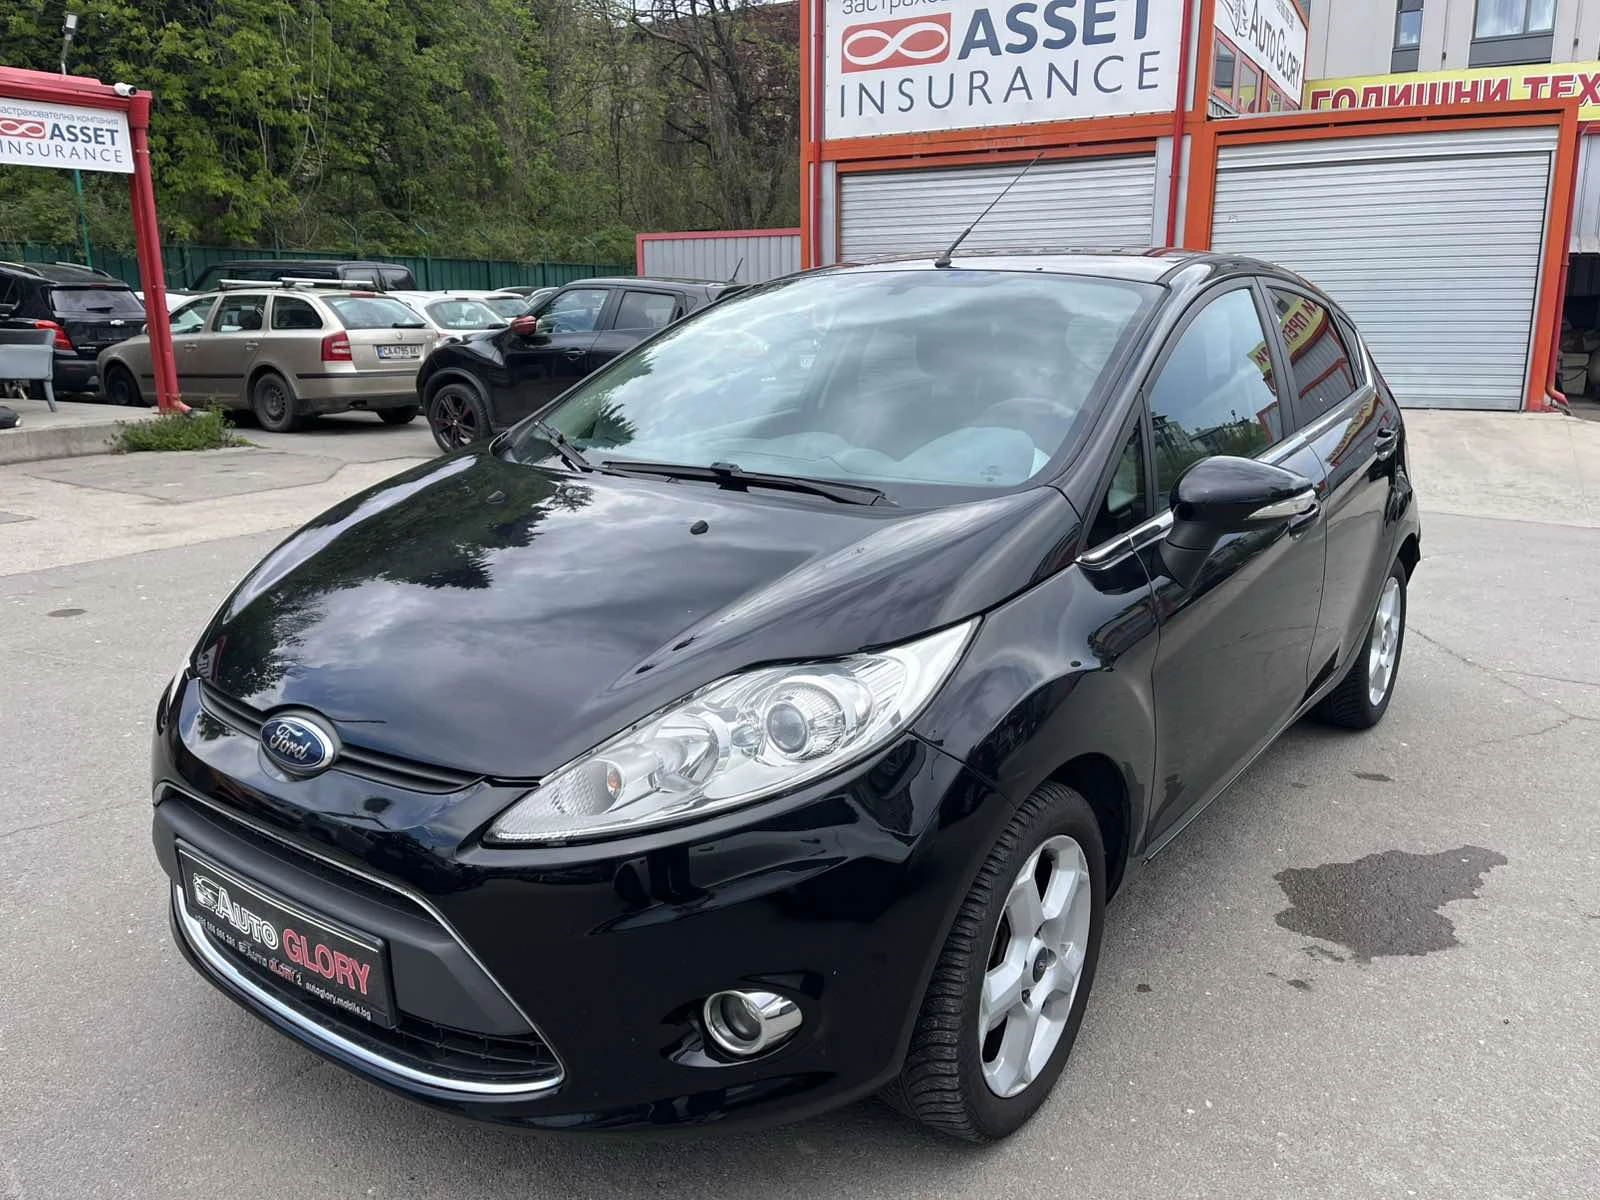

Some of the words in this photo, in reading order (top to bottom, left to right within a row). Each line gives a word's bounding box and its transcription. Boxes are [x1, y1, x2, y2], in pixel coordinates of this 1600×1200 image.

[957, 0, 1149, 60] ASSET
[840, 51, 1161, 118] INSURANCE
[0, 140, 123, 163] INSURANCE
[49, 123, 119, 146] ASSET
[270, 723, 311, 760] Ford
[283, 928, 370, 996] GLORY
